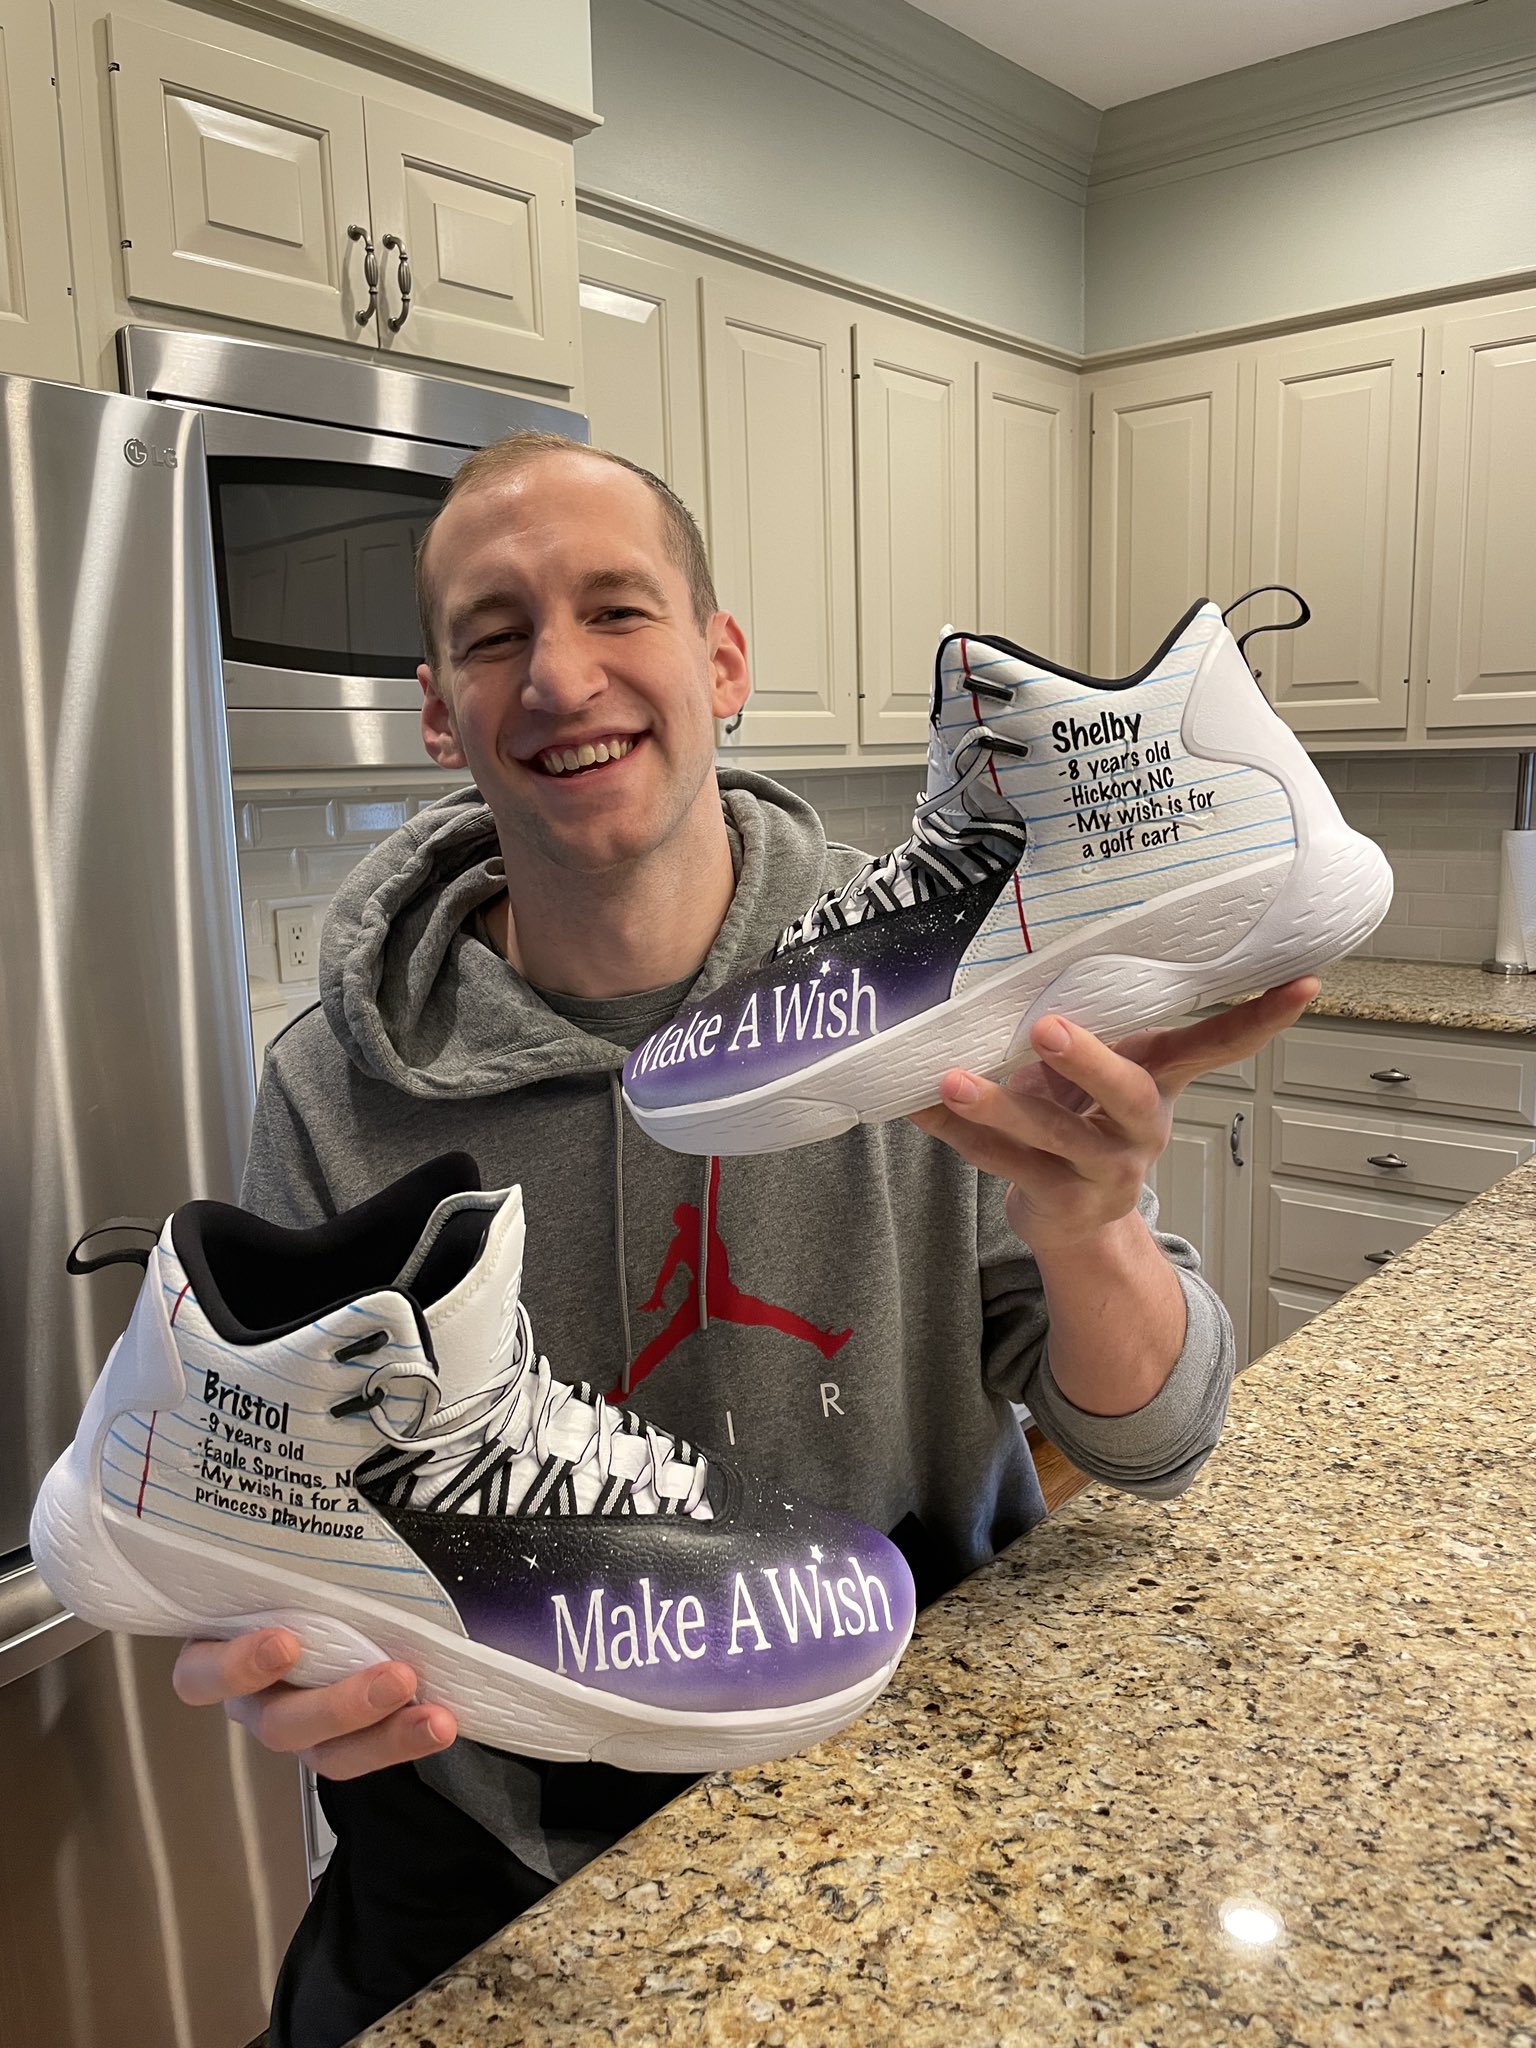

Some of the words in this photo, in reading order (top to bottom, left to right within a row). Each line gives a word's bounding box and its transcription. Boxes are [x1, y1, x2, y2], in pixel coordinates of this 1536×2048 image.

[151, 444, 178, 469] LG
[1051, 711, 1142, 753] Shelby
[1058, 758, 1080, 780] -8
[1087, 750, 1140, 780] years
[1145, 740, 1171, 764] old
[1067, 810, 1111, 833] -My
[1116, 797, 1163, 825] wish
[1167, 795, 1183, 815] is
[1187, 788, 1215, 811] for
[1081, 843, 1094, 859] a
[1099, 828, 1135, 859] golf
[1141, 821, 1180, 847] cart
[630, 1010, 723, 1080] Make
[728, 992, 762, 1052] A
[773, 959, 880, 1044] Wish
[203, 1369, 289, 1434] Bristol
[200, 1412, 220, 1433] -9
[223, 1421, 272, 1454] years
[278, 1441, 305, 1461] old
[193, 1459, 233, 1489] -My
[238, 1475, 283, 1501] wish
[289, 1487, 304, 1507] is
[310, 1491, 341, 1512] for
[346, 1498, 359, 1512] a
[195, 1485, 267, 1519] princess
[271, 1507, 364, 1540] playhouse
[550, 1577, 707, 1675] Make
[726, 1571, 772, 1655] A
[762, 1543, 894, 1645] Wish
